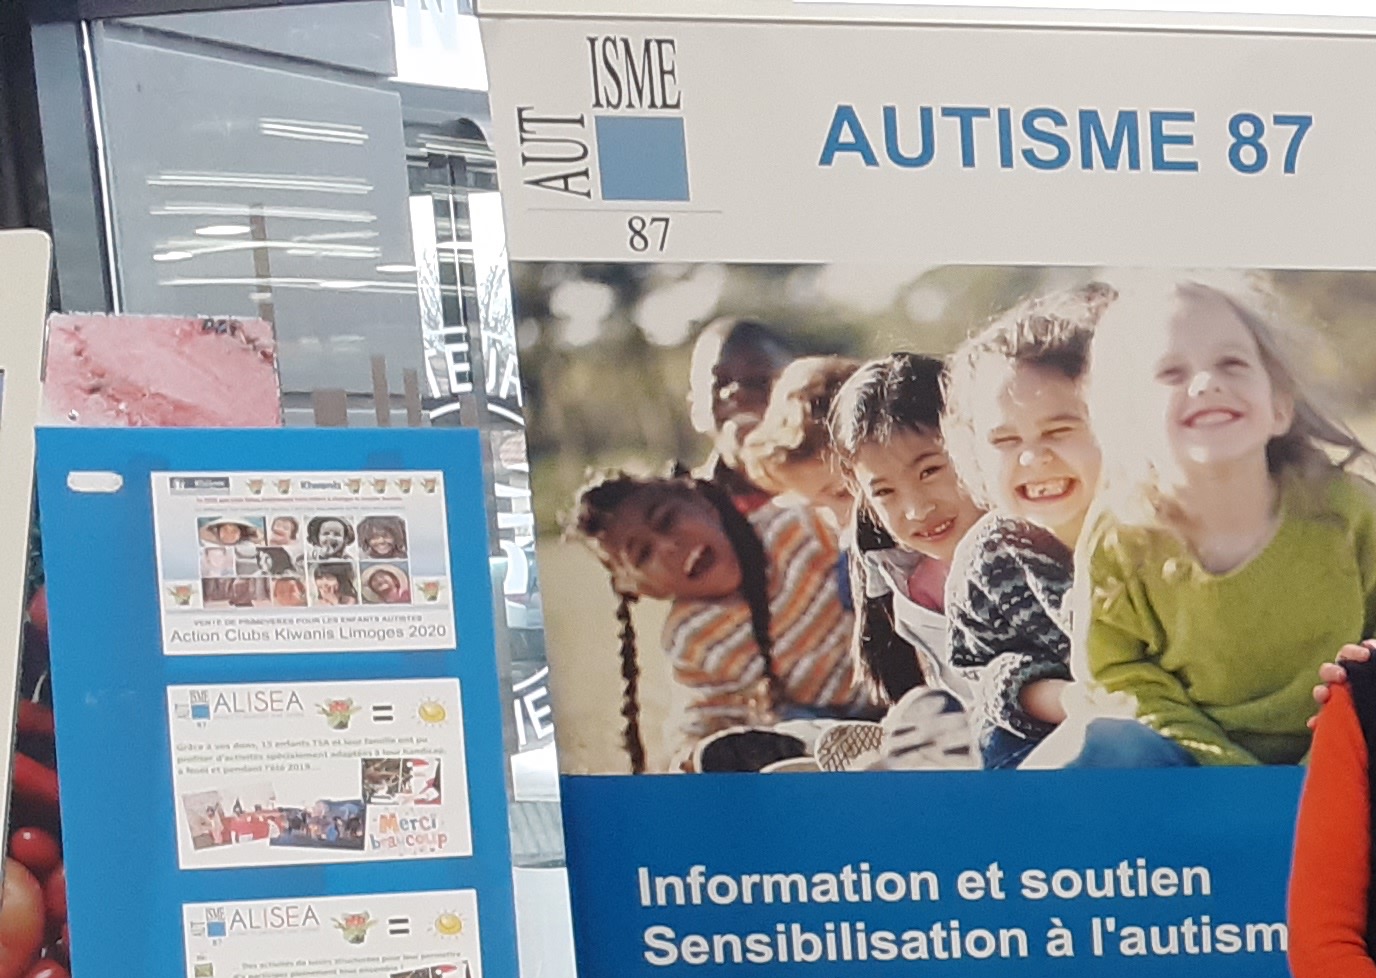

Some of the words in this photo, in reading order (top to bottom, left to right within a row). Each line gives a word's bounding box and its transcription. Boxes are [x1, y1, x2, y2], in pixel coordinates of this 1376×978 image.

[586, 36, 682, 111] ISME
[517, 106, 591, 199] AUT
[818, 104, 1199, 174] AUTISME
[1225, 112, 1315, 175] 87
[627, 216, 670, 253] 87
[170, 629, 220, 642] Action
[225, 628, 270, 642] Clubs
[275, 627, 334, 641] Kiwanis
[340, 626, 404, 641] Limoges
[408, 625, 446, 638] 2020
[213, 690, 304, 713] ALISEA
[379, 813, 437, 834] Merci
[637, 865, 941, 908] Information
[956, 862, 1005, 902] et
[1020, 858, 1212, 901] soutien
[229, 905, 320, 930] ALISEA
[642, 920, 1030, 968] Sensibilisation
[1045, 917, 1075, 960] à
[1090, 915, 1289, 957] l'autism
